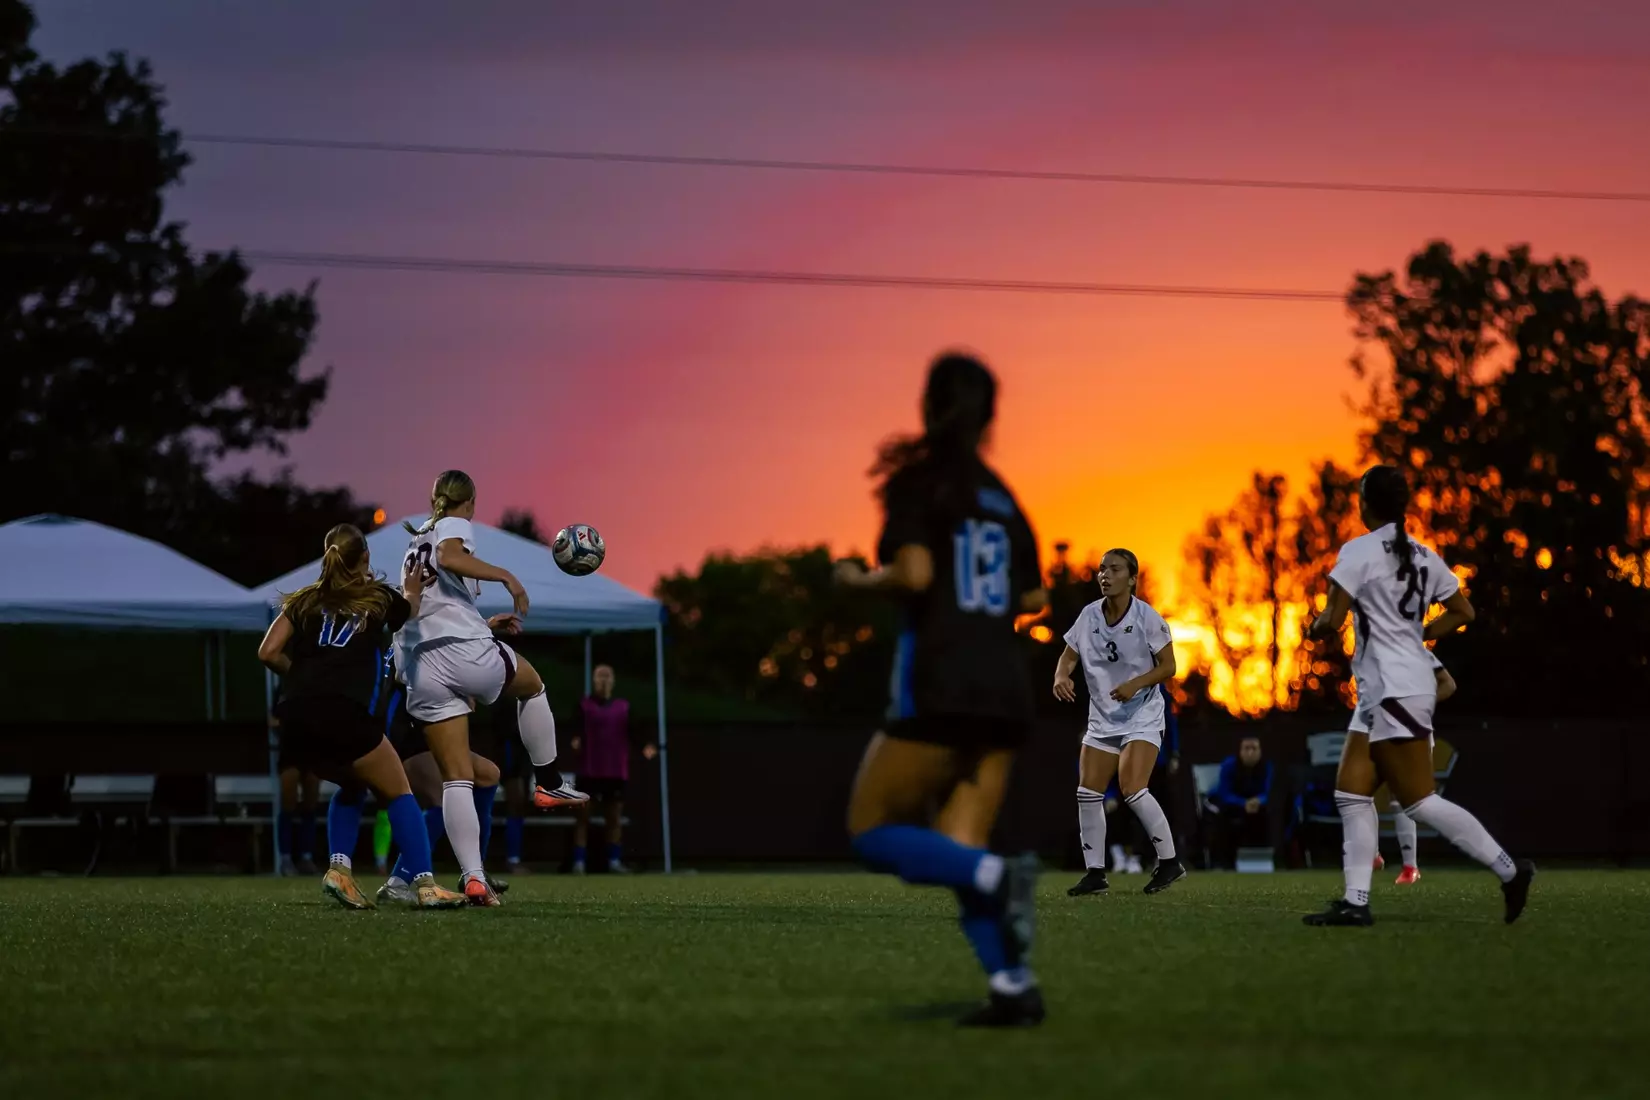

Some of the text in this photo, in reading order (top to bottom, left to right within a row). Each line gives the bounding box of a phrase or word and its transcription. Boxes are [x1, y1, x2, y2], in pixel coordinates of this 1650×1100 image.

[954, 517, 1011, 616] 13
[1396, 564, 1428, 622] 21
[1106, 641, 1119, 663] 3
